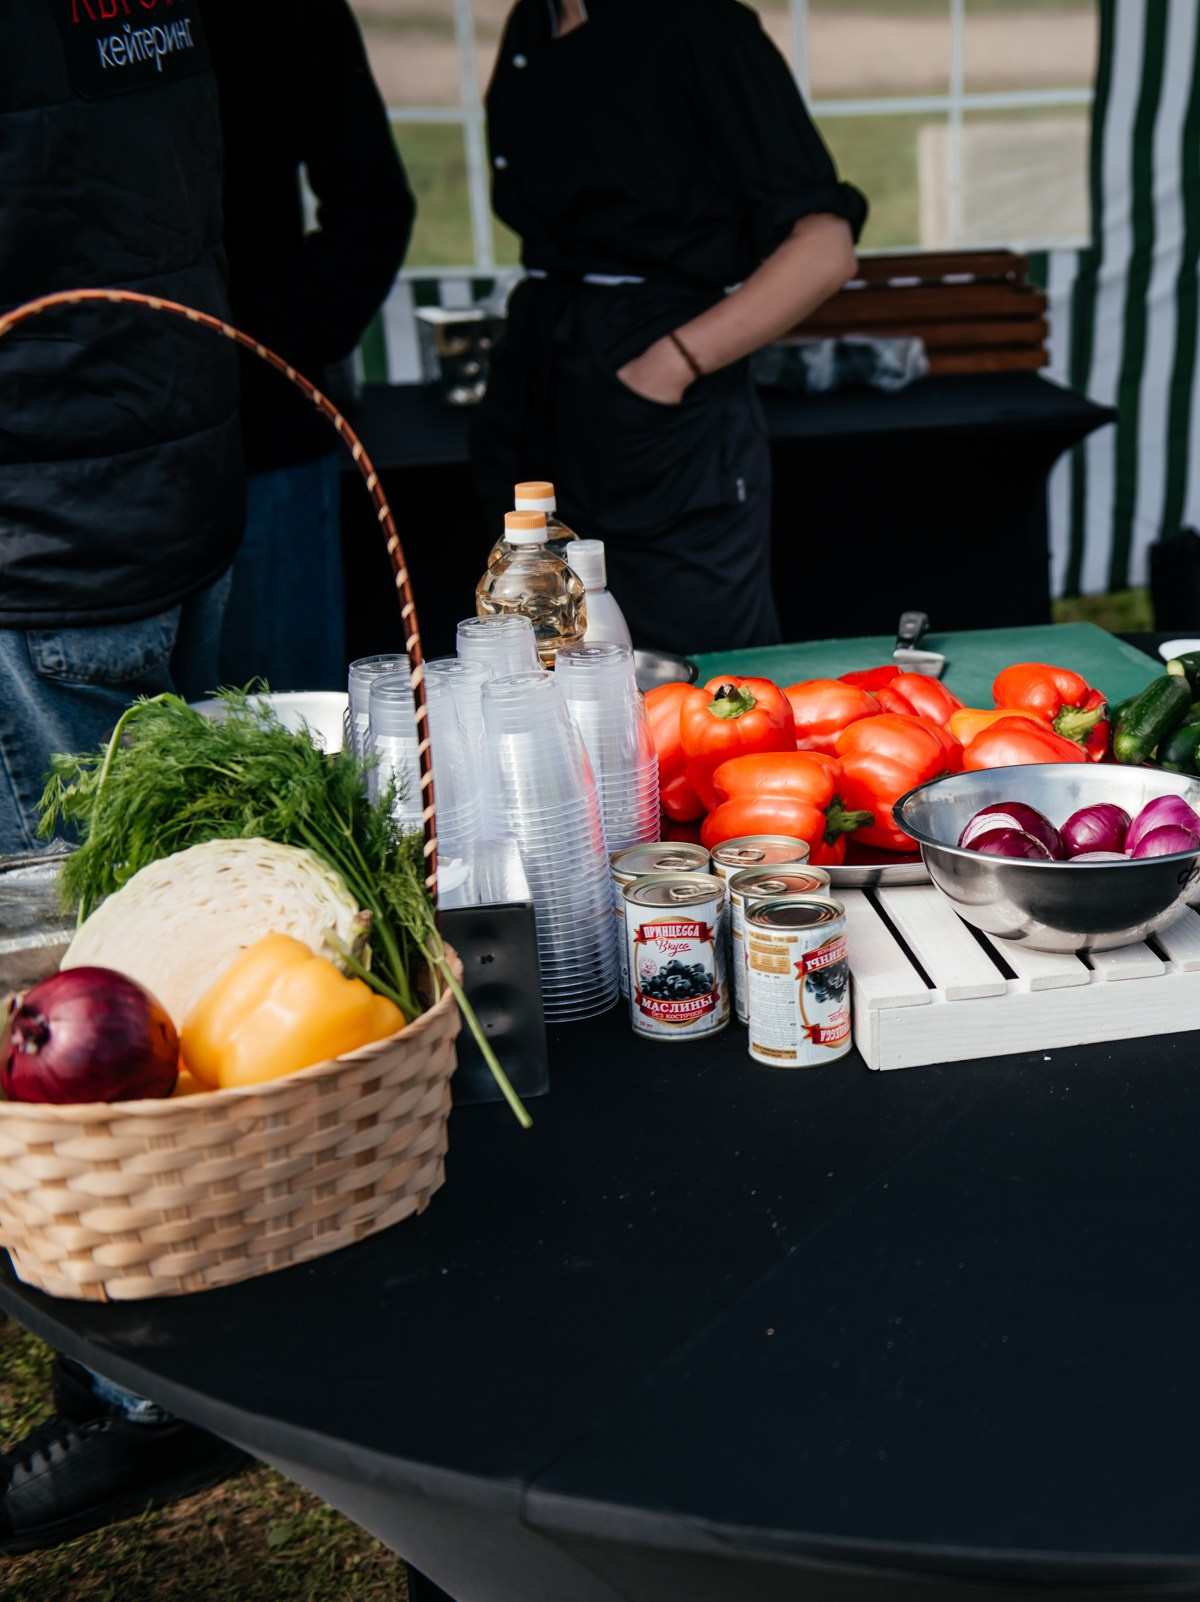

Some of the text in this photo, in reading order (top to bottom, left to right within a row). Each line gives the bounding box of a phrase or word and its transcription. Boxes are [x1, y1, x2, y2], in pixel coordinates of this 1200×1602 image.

[96, 18, 195, 72] кейтеринг
[643, 925, 700, 938] ПРИНЦЕССА
[641, 995, 713, 1013] МАСЛИНЫ
